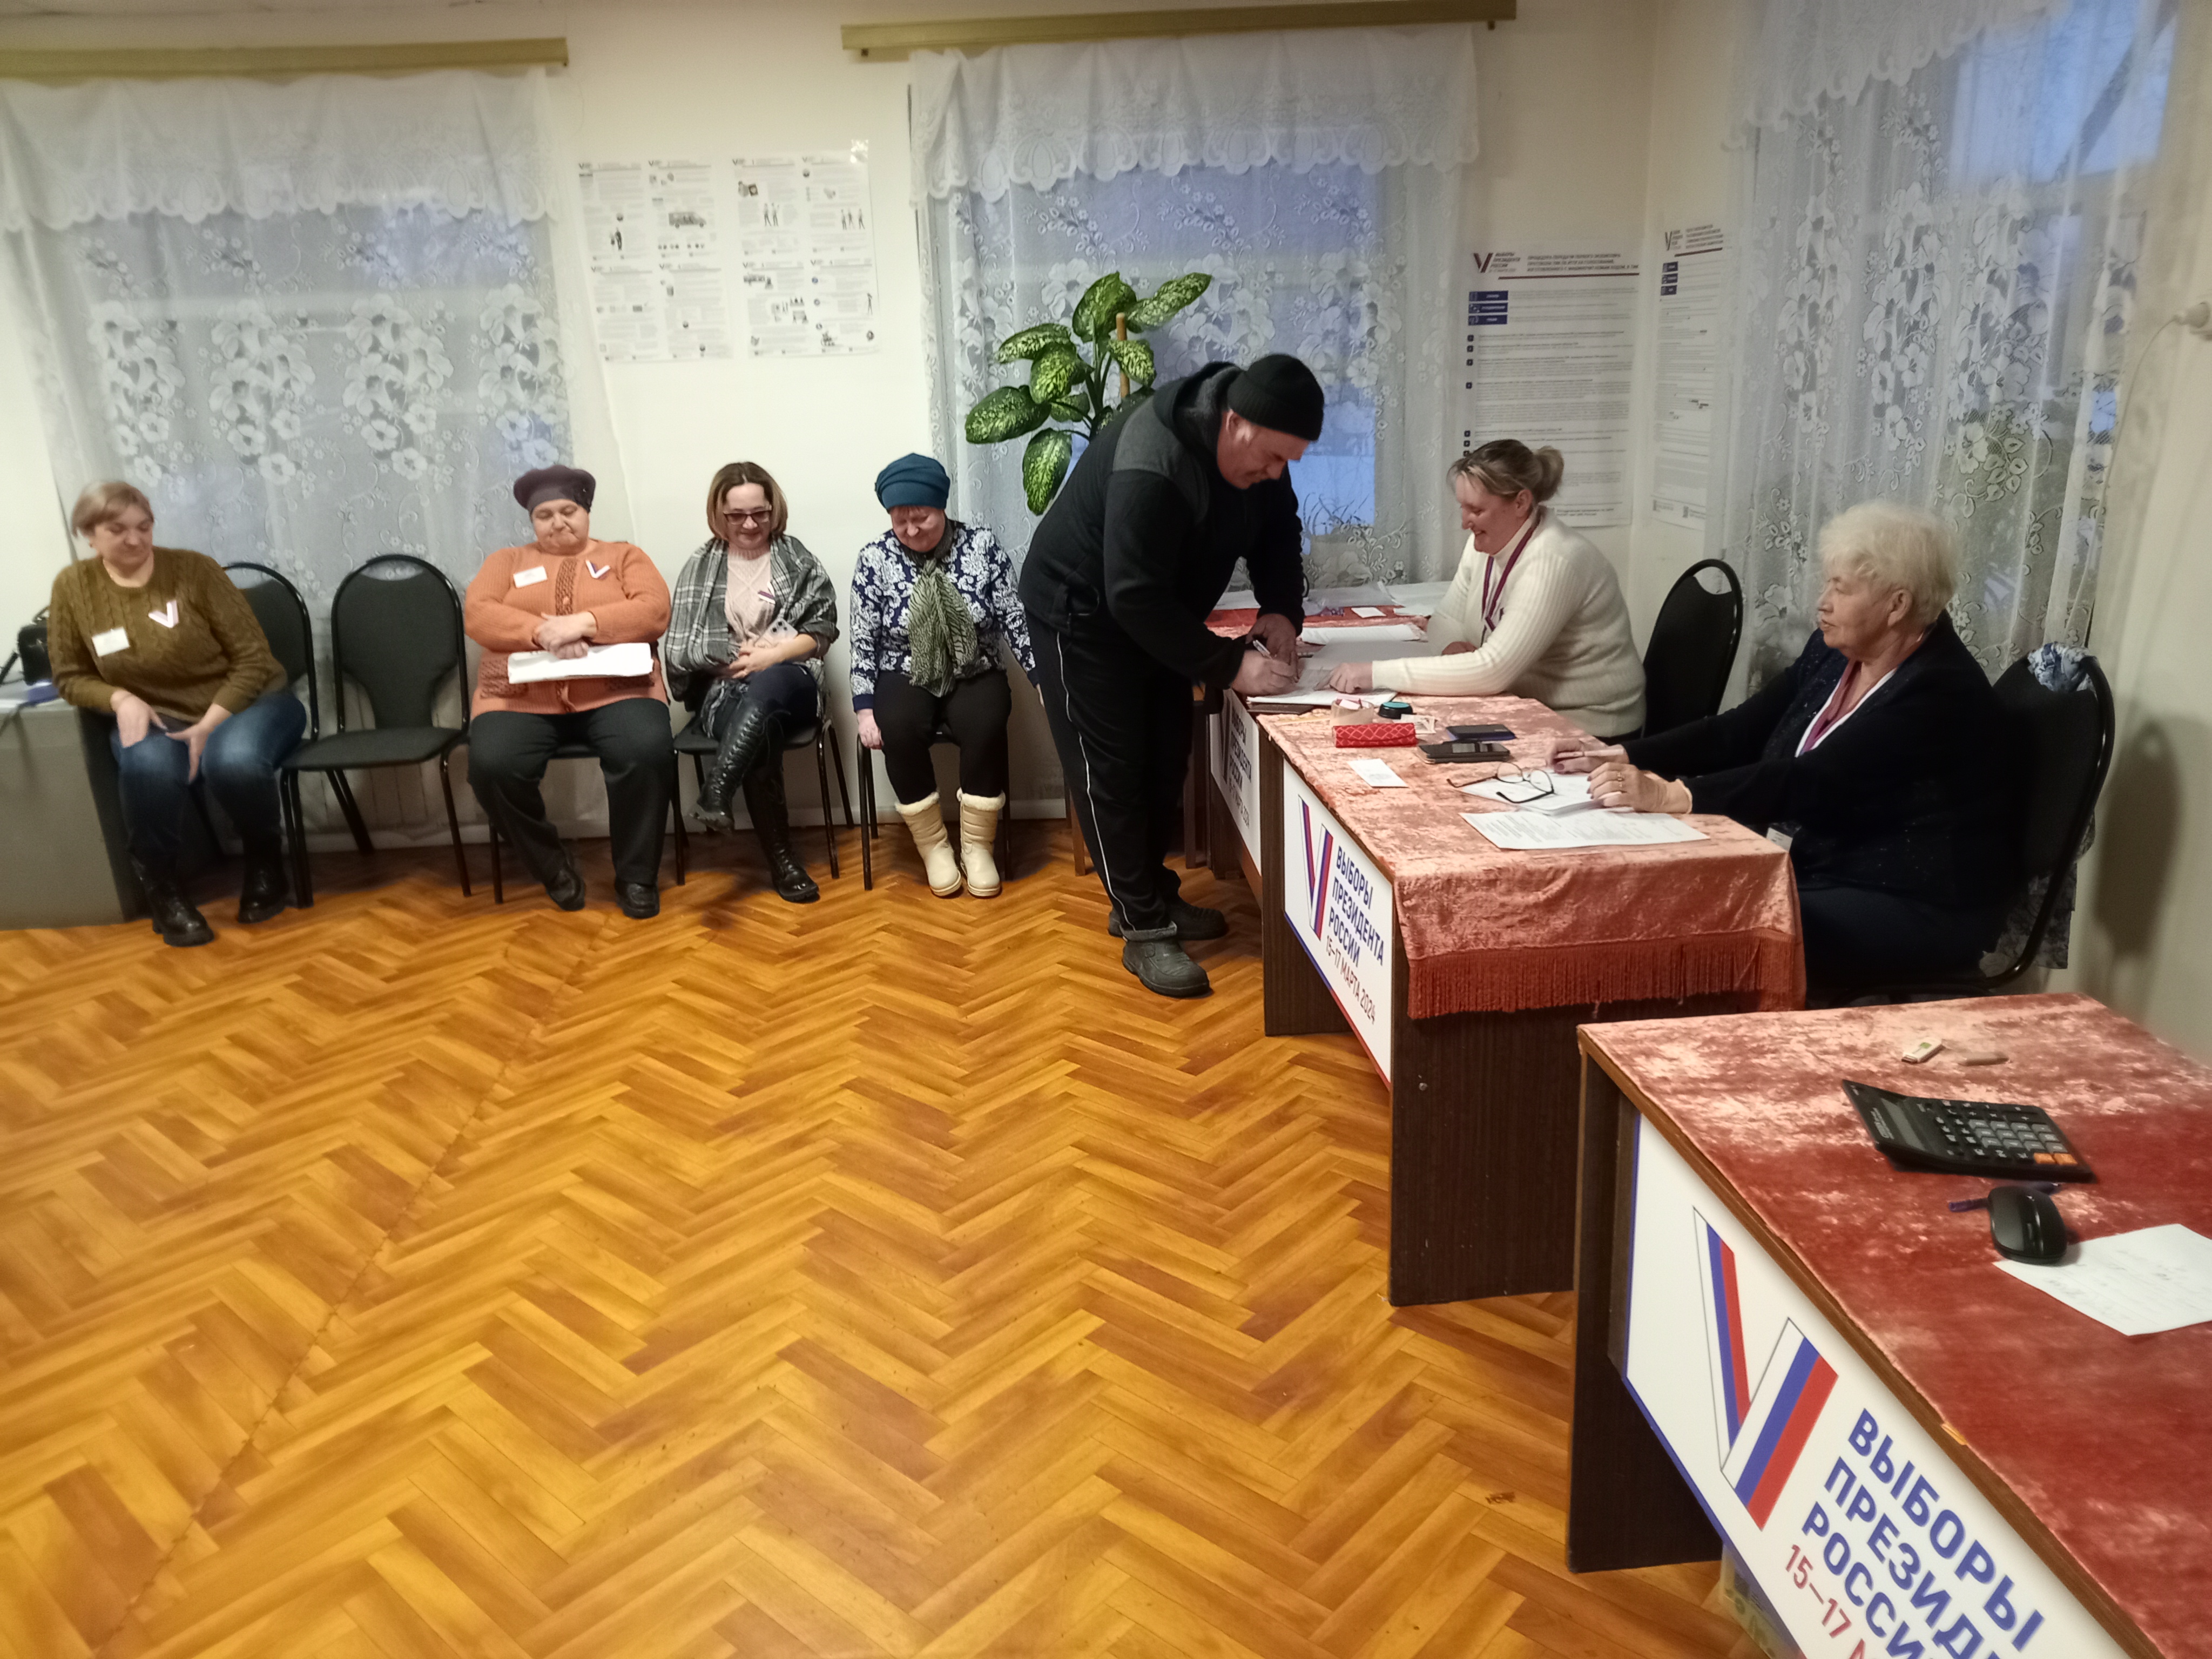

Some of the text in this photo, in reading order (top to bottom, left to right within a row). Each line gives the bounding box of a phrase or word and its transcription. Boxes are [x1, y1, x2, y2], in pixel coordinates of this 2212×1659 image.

[1337, 845, 1373, 910] ВЫБОРЫ
[1328, 906, 1360, 968] РОССИИ
[1332, 876, 1384, 967] ПРЕЗИДЕНТА
[1340, 956, 1360, 1002] МАРТА
[1360, 988, 1376, 1025] 2024
[1847, 1407, 2045, 1653] ВЫБОРЫ
